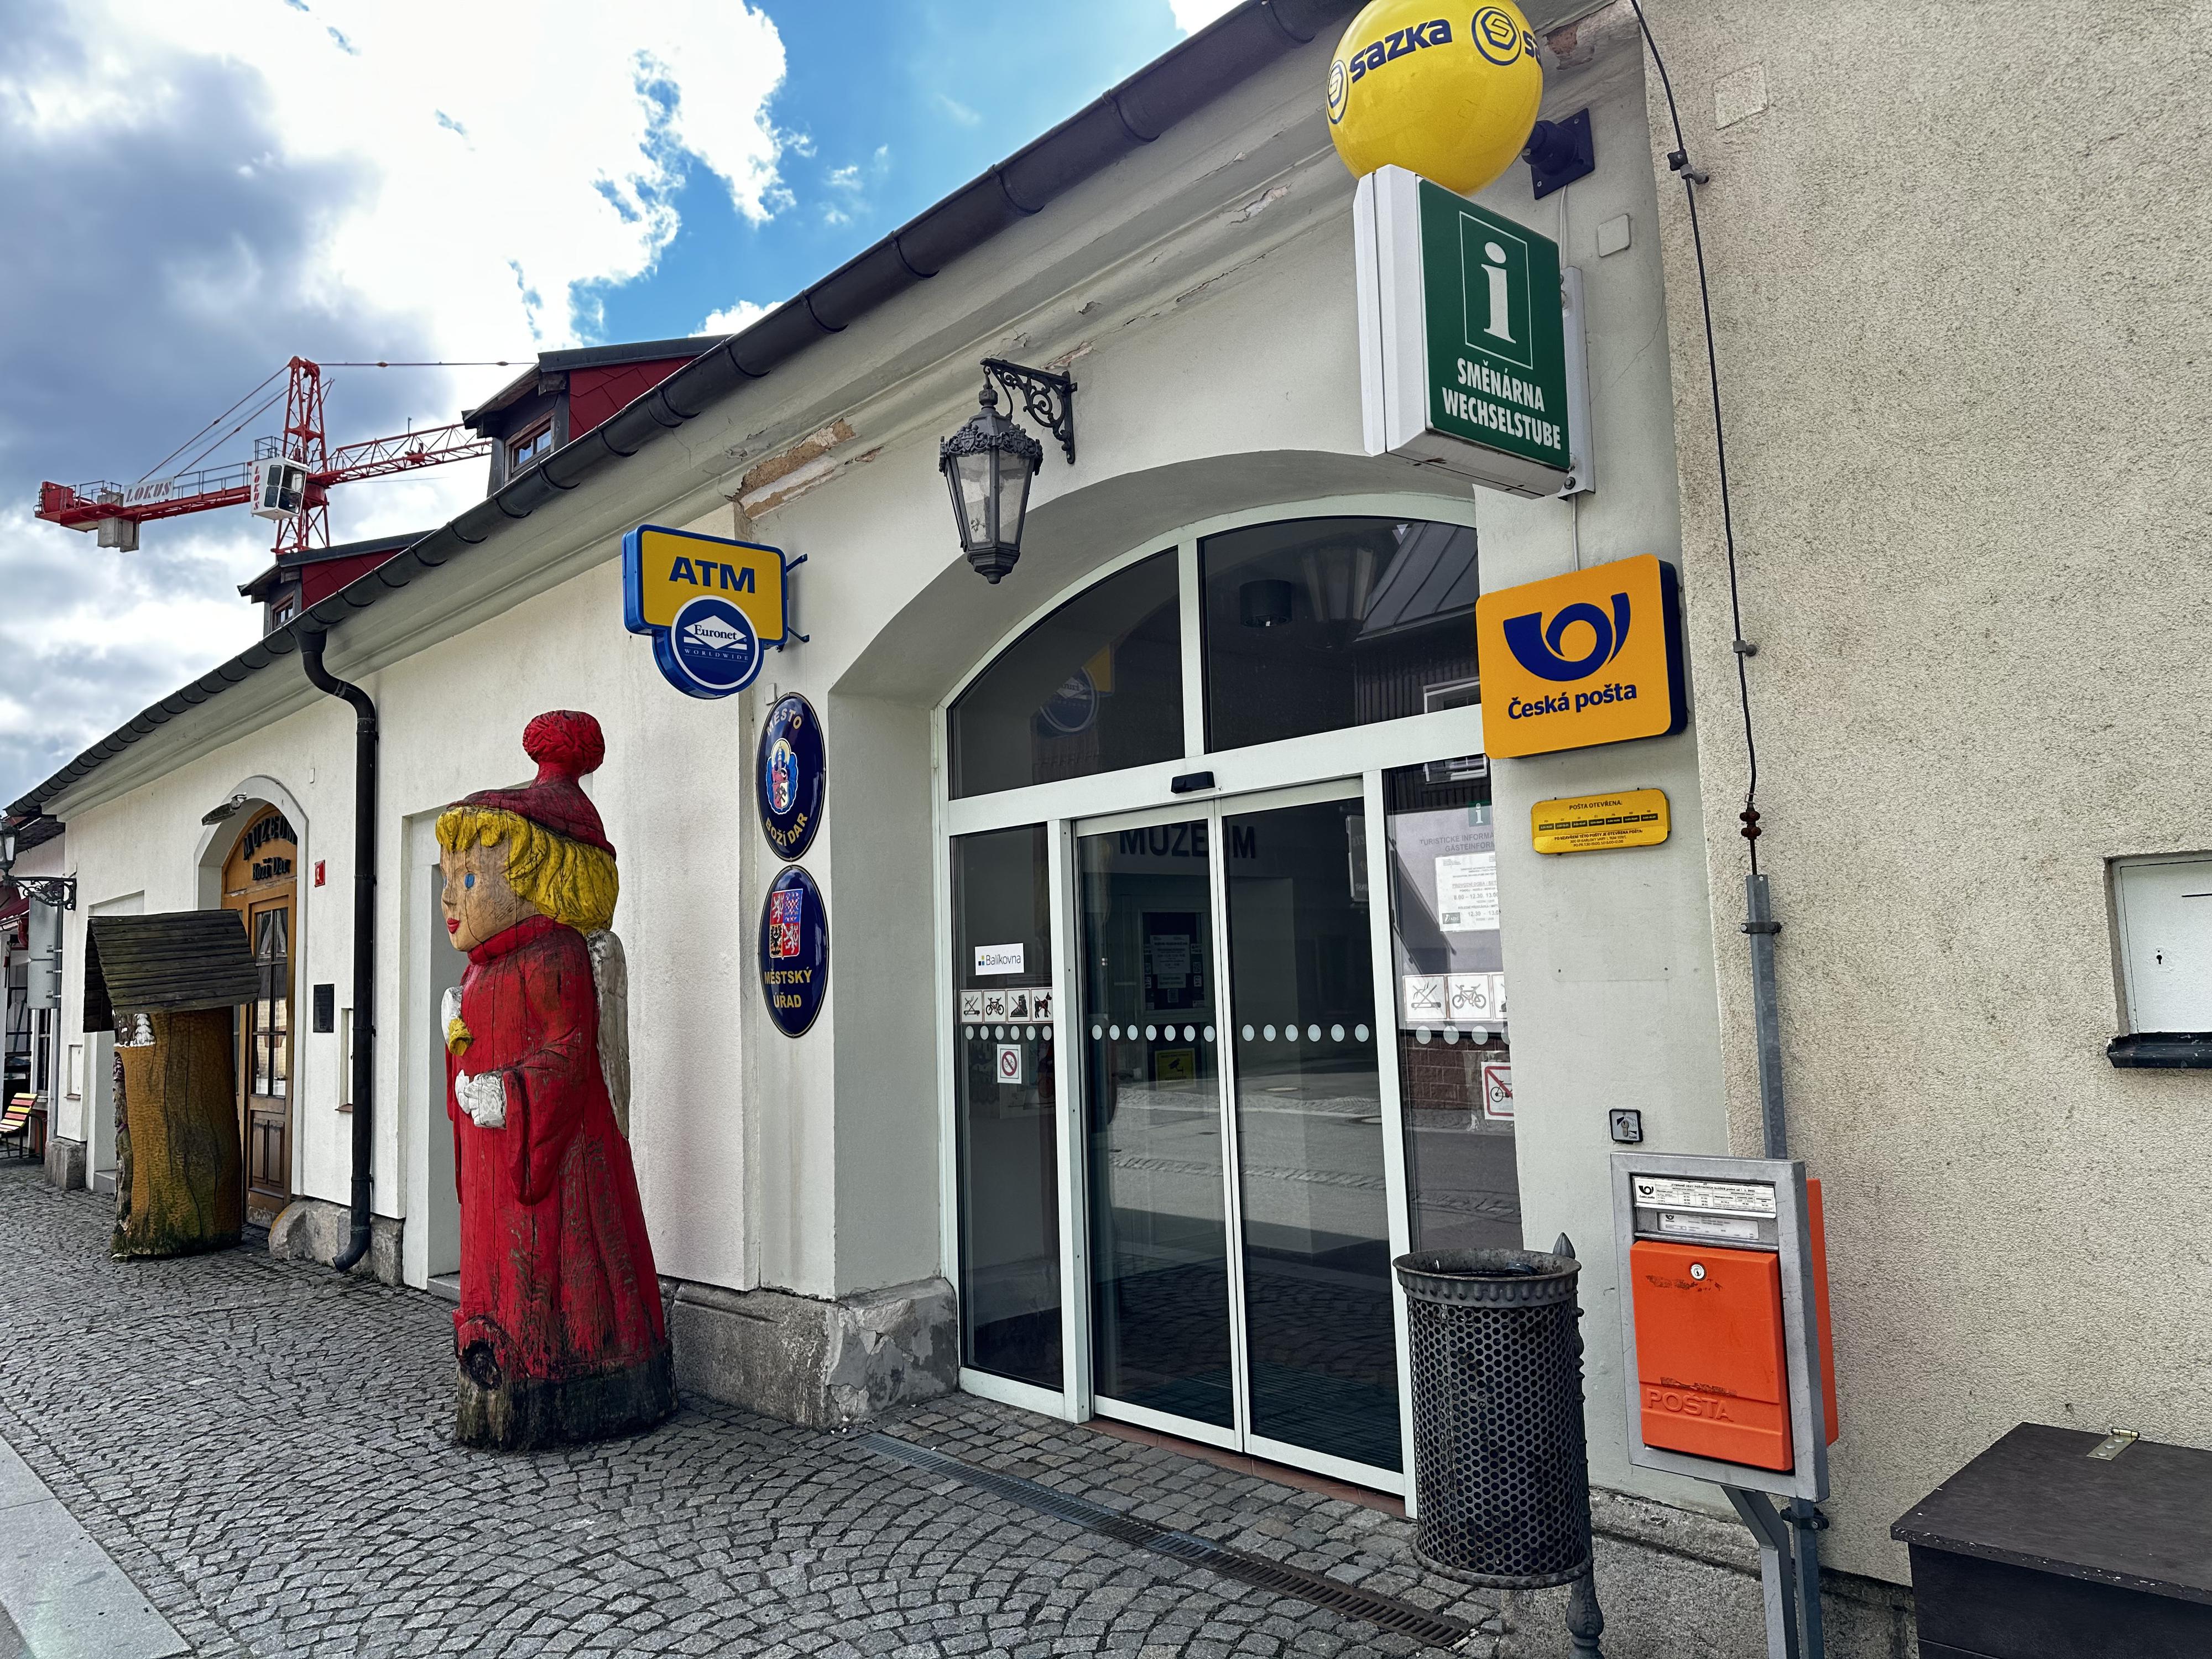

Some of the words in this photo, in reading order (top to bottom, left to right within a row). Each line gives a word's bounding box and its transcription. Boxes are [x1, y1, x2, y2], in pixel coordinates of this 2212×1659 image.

[1457, 358, 1545, 412] SMĚNÁRNA
[1442, 387, 1561, 450] WECHSELSTUBE
[125, 480, 173, 503] LOKUS
[669, 556, 755, 593] ATM
[694, 624, 737, 640] Euronet
[685, 648, 749, 661] WORLDWIDE
[1508, 692, 1569, 720] Česká
[1575, 683, 1637, 713] pošta
[766, 708, 802, 737] MĚSTO
[765, 817, 786, 847] BOŽÍ
[787, 812, 808, 844] DAR
[1120, 823, 1255, 859] MUZEM
[764, 966, 812, 985] MĚSTSKÝ
[985, 954, 1021, 966] Balíkovna
[773, 992, 802, 1009] ÚŘAD
[1646, 1387, 1735, 1423] POŠTA
